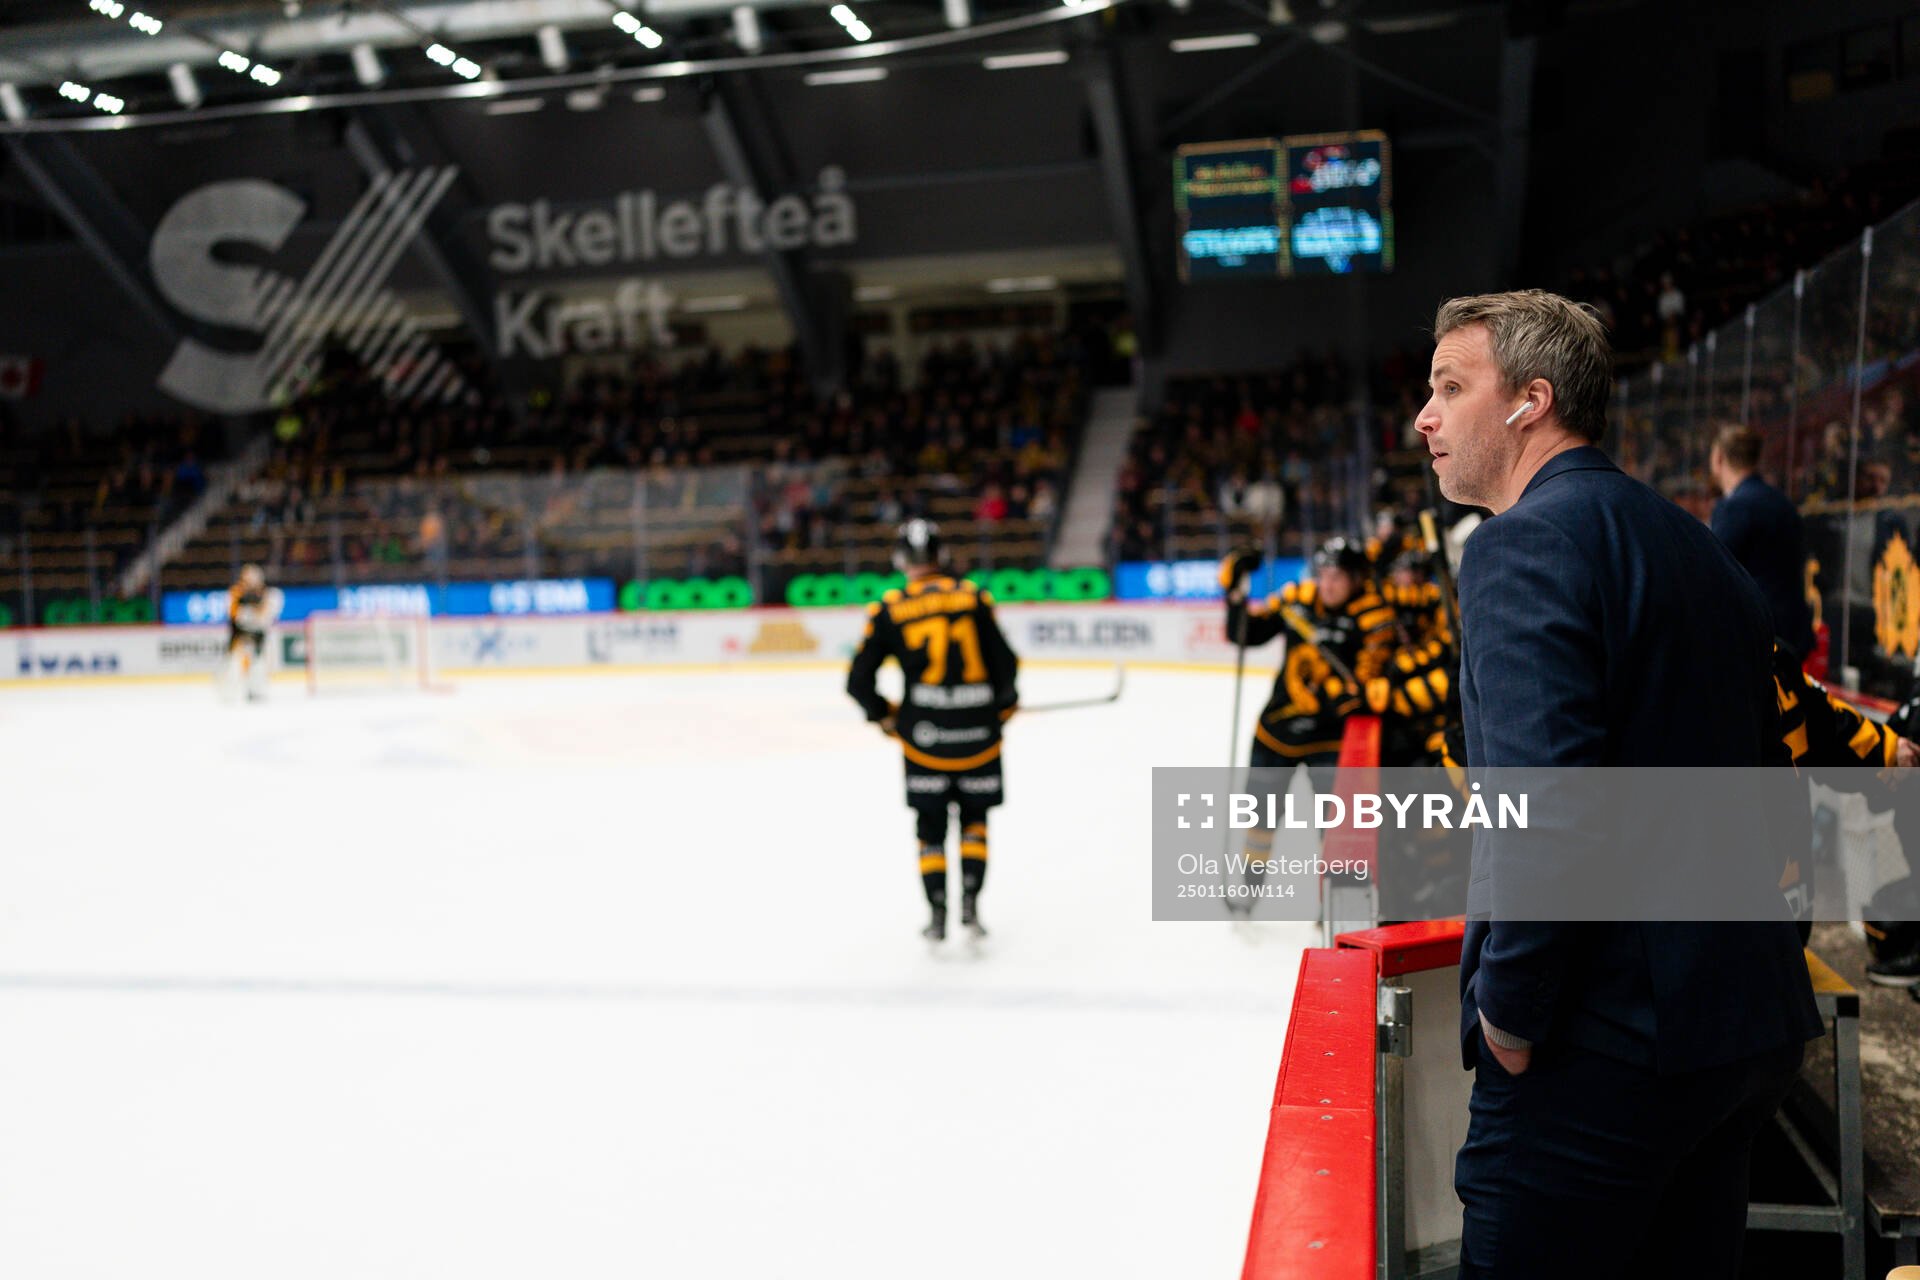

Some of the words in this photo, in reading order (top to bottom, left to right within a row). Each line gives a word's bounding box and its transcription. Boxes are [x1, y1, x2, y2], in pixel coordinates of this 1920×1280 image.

[488, 166, 857, 270] Skellefteå
[499, 281, 676, 359] Kraft
[903, 615, 988, 686] 71
